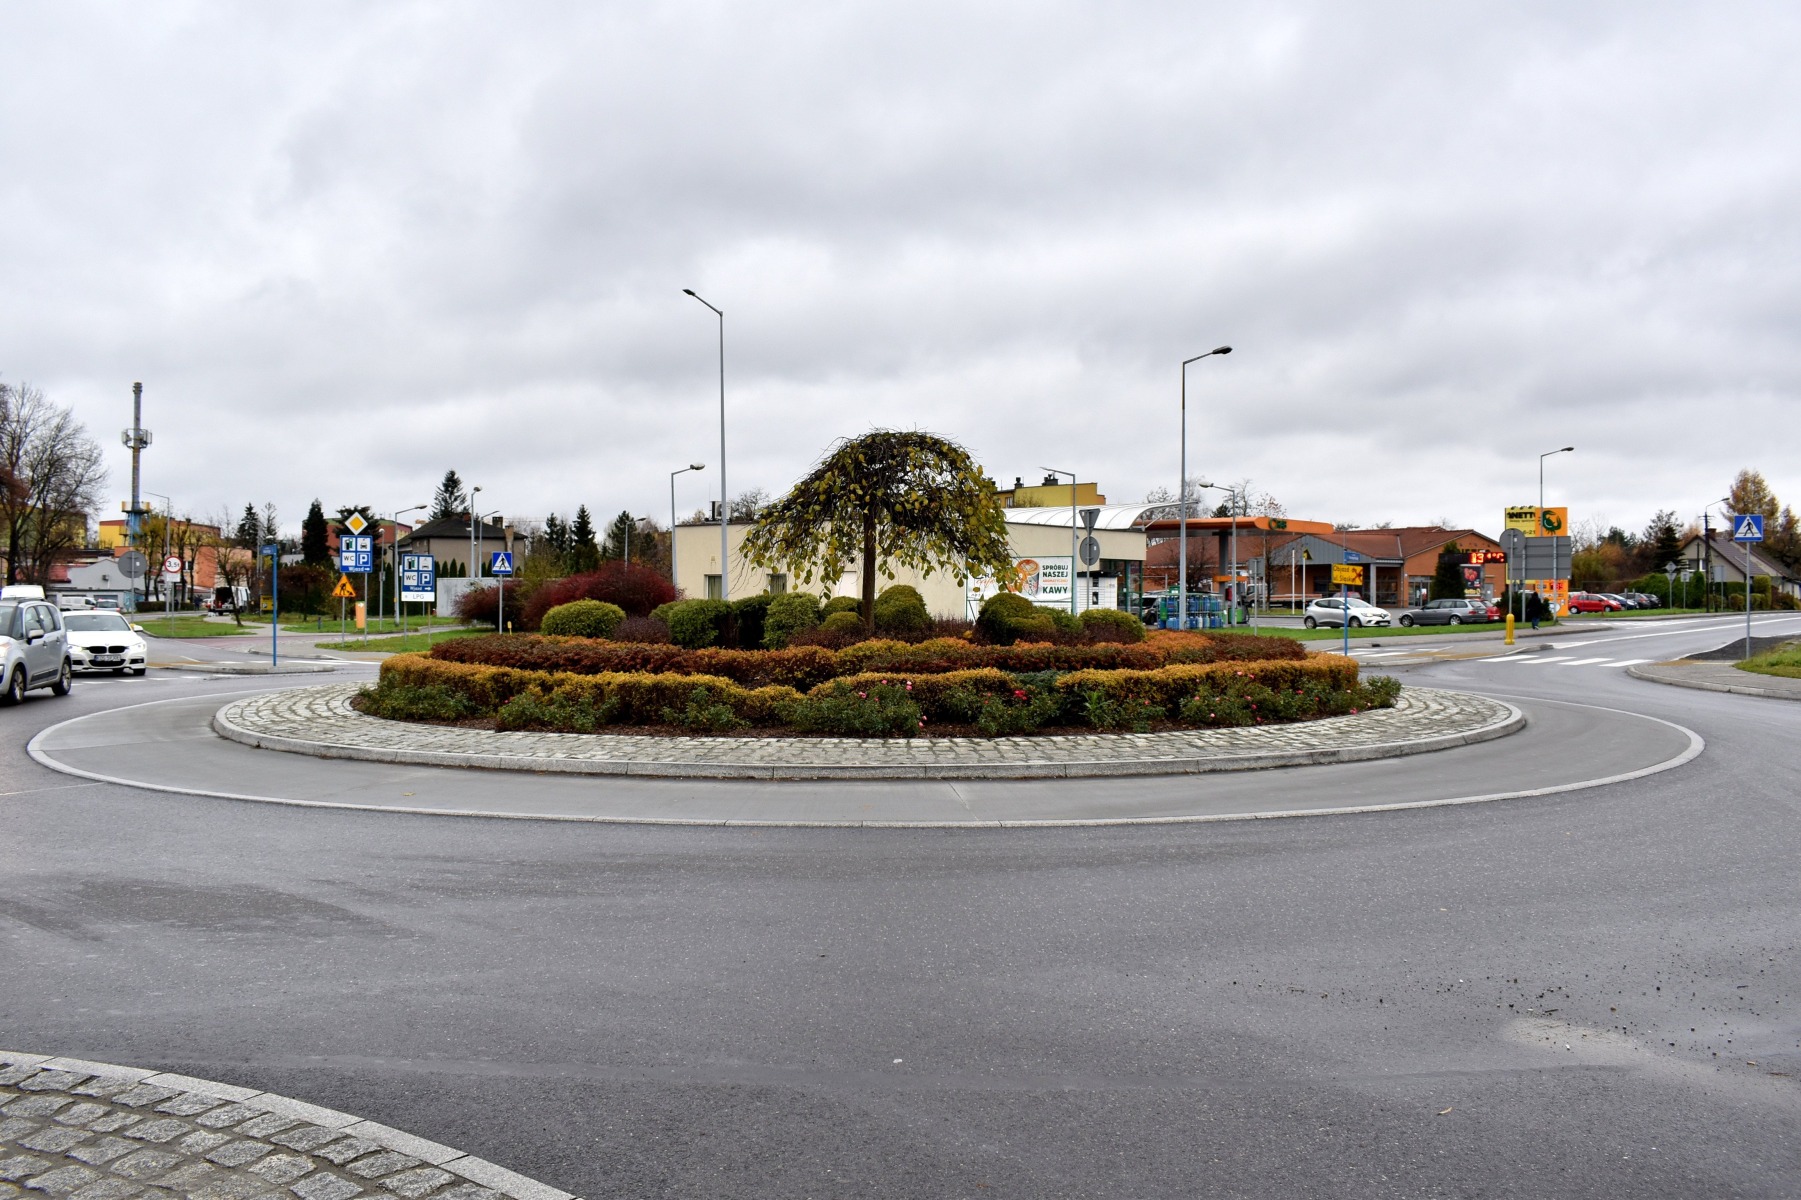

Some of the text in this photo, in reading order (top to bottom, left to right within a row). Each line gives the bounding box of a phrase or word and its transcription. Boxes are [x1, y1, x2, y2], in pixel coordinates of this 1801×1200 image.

[360, 554, 368, 565] P
[1333, 564, 1350, 573] Objazd
[421, 573, 430, 584] P
[1042, 586, 1068, 594] KAWY
